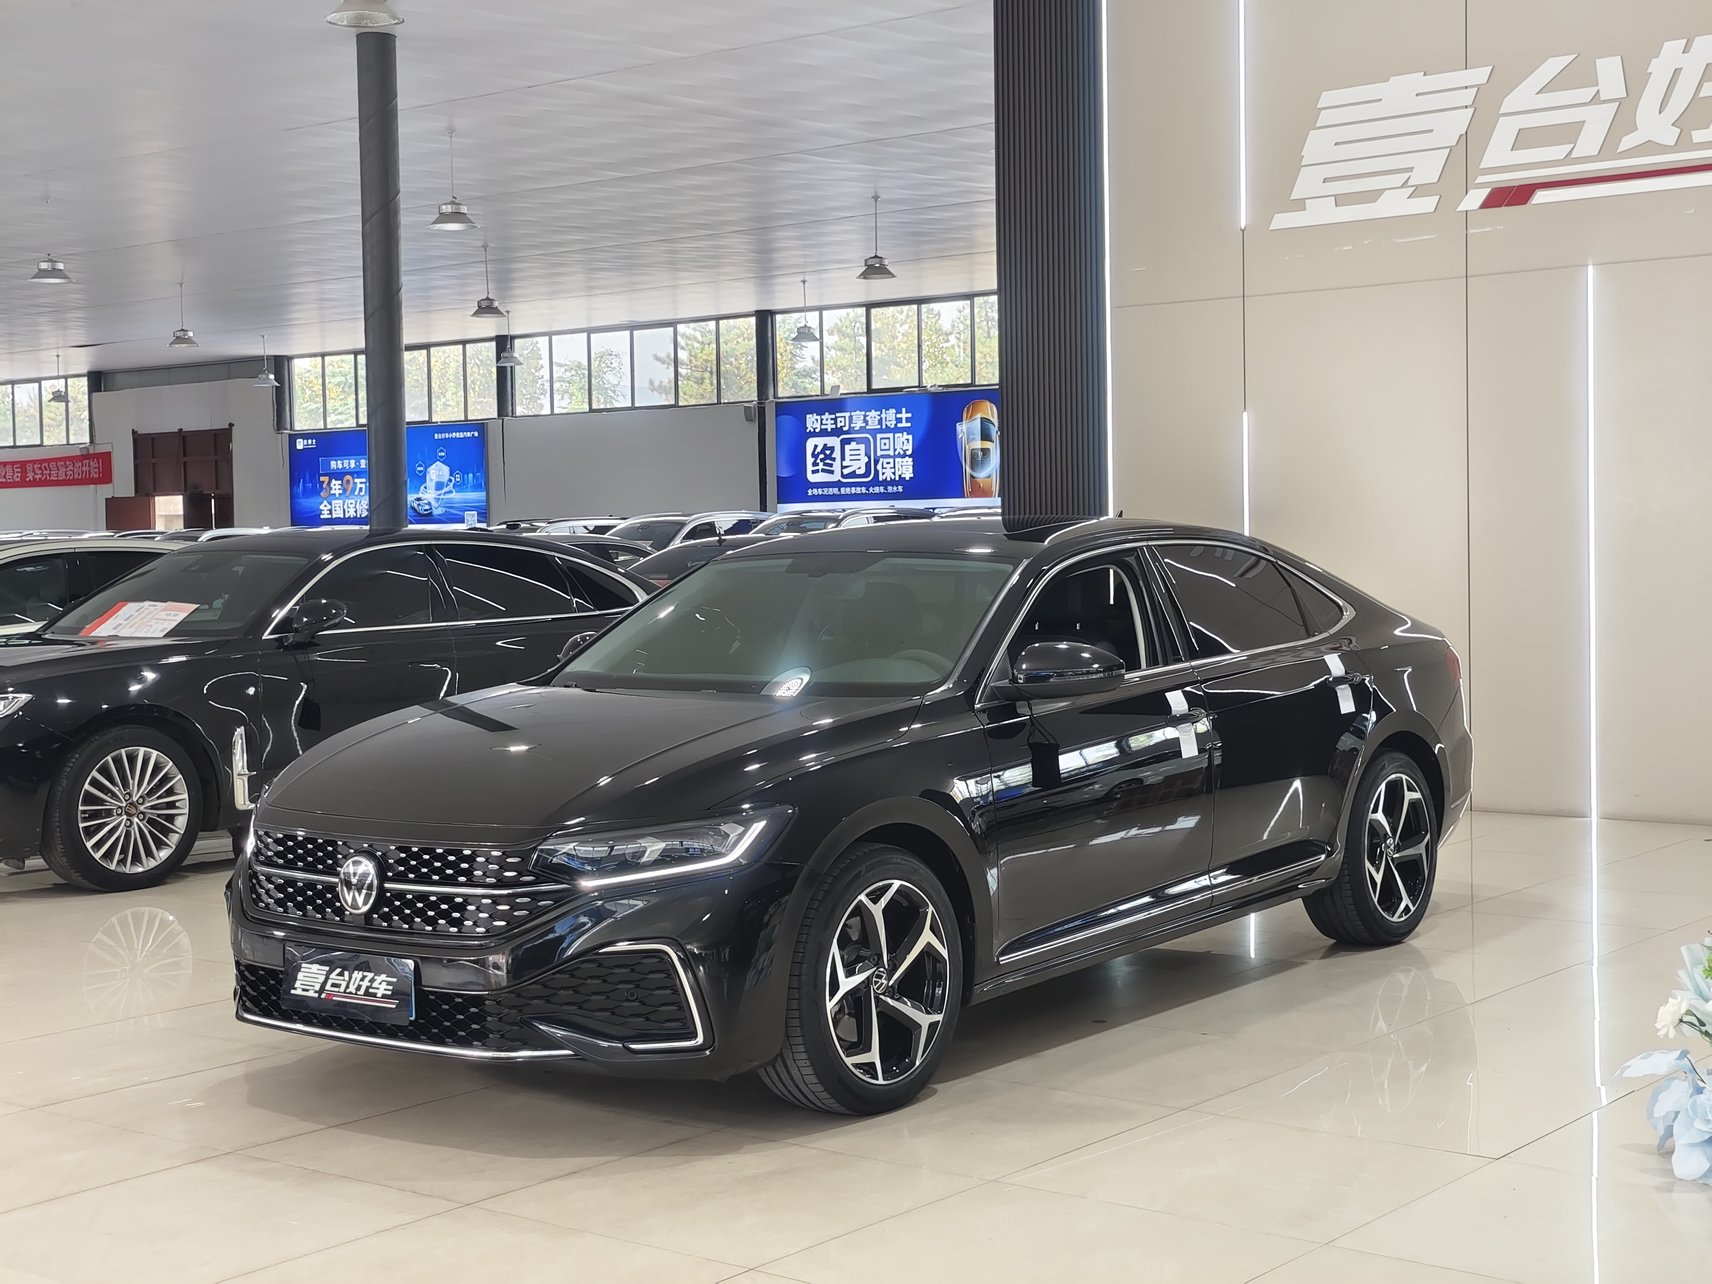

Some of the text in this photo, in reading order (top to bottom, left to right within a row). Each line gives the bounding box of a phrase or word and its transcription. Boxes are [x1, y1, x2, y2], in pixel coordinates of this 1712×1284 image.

[806, 408, 912, 432] 购车可享查博士
[876, 432, 913, 456] 回购
[330, 459, 368, 470] 购车可享·查
[811, 441, 869, 476] 终身
[877, 457, 914, 481] 保障
[320, 474, 368, 498] 3年9万
[320, 499, 369, 519] 全国保修
[290, 963, 398, 998] 壹台好车
